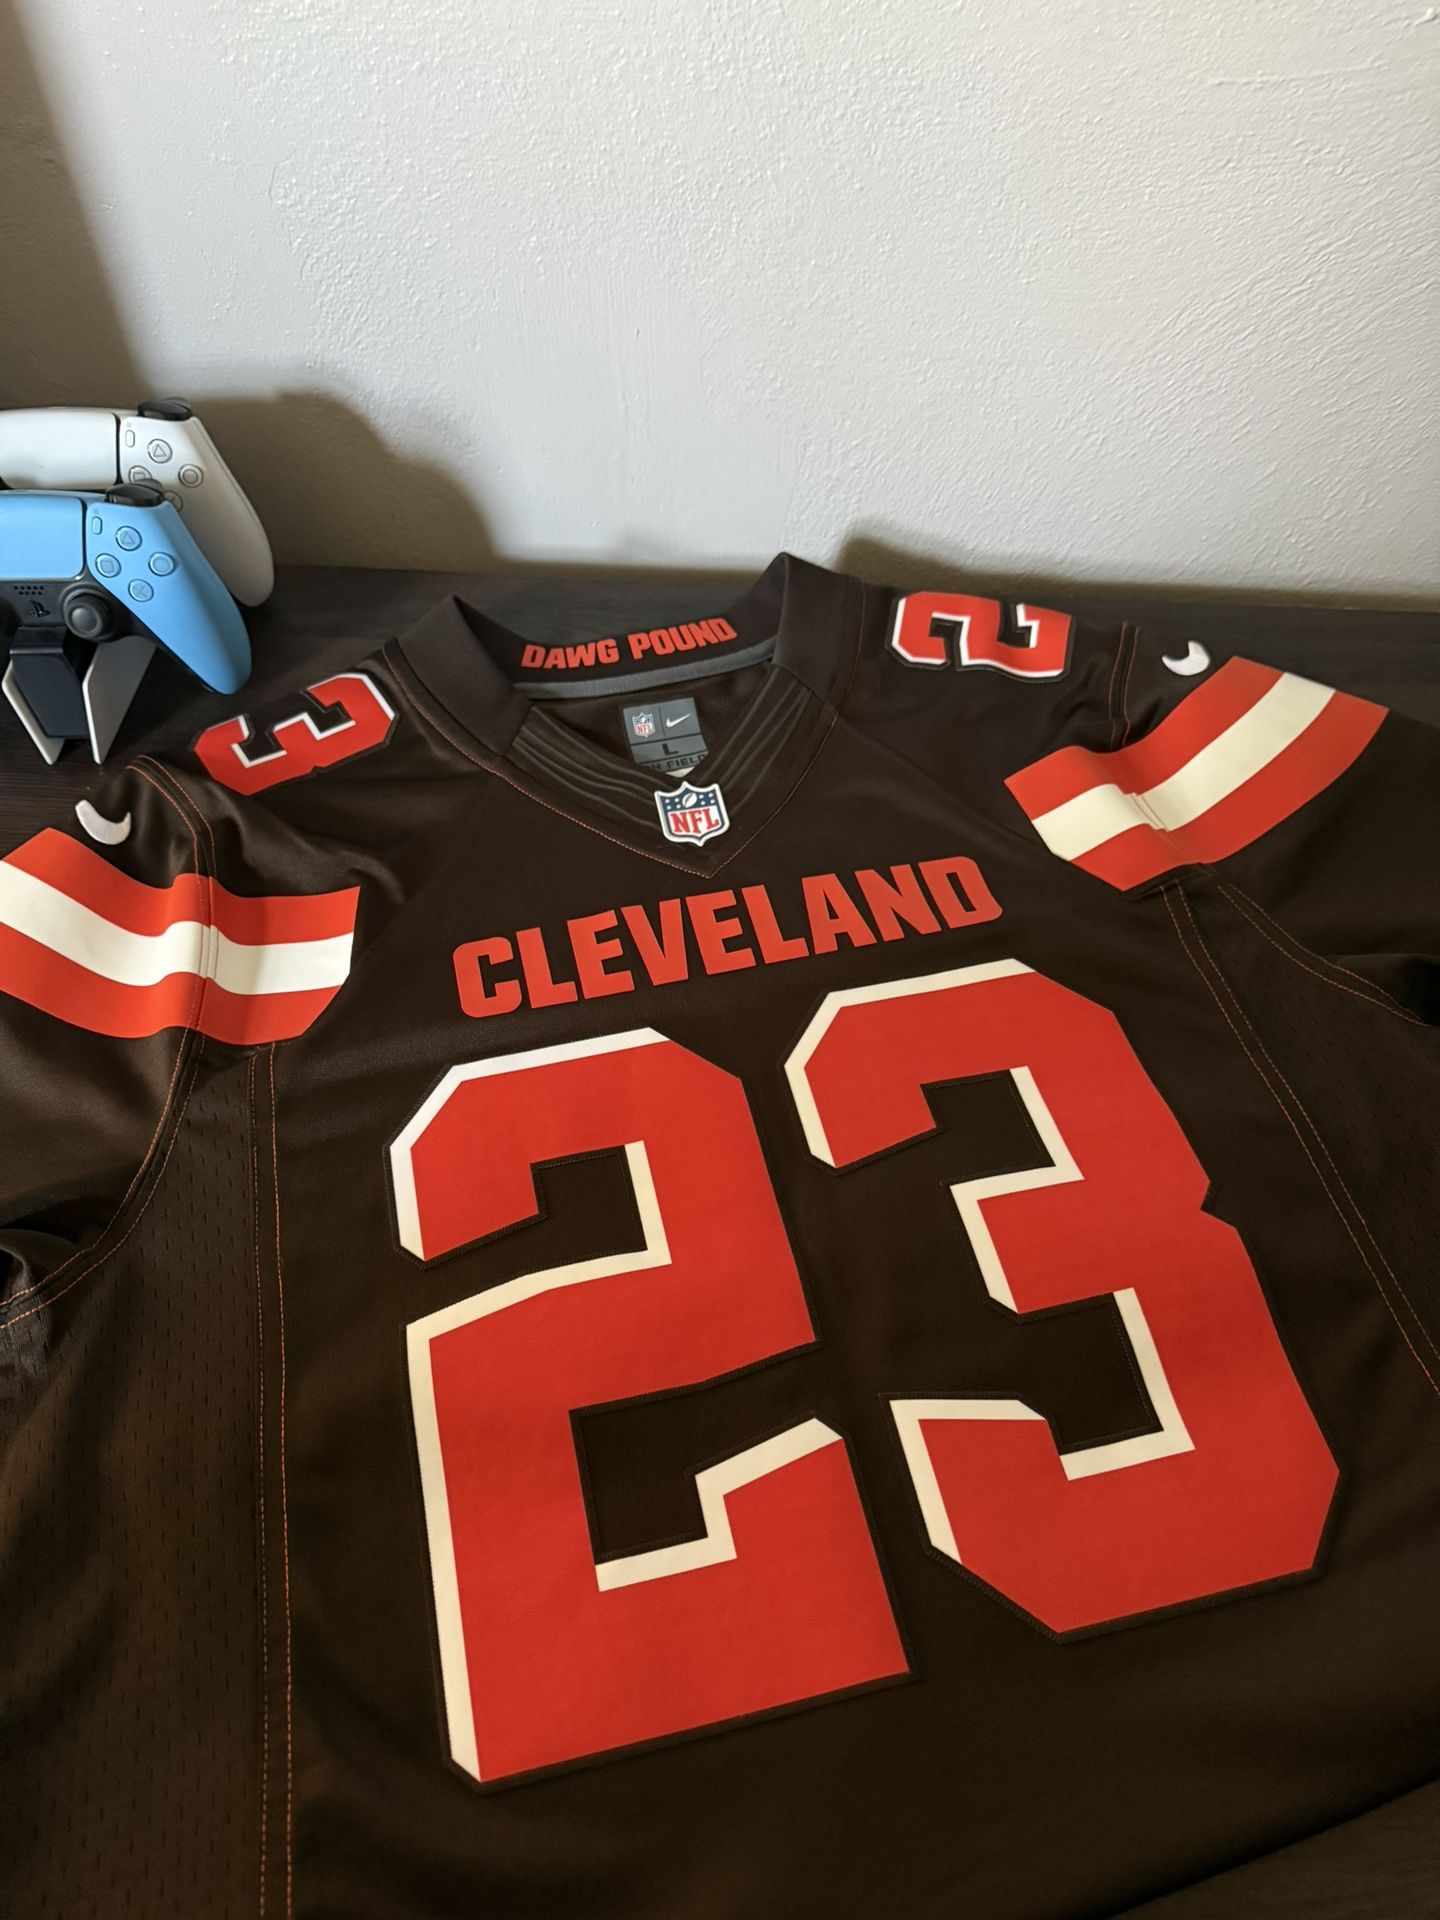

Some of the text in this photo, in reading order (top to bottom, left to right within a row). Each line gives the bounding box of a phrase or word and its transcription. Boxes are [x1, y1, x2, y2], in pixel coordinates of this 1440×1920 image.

[520, 617, 738, 669] DAWG POUND
[891, 592, 1073, 678] 2
[194, 672, 396, 797] 3
[661, 743, 679, 756] L
[668, 808, 720, 834] NFL
[452, 856, 1003, 1018] CLEVELAND
[389, 958, 1340, 1784] 23
